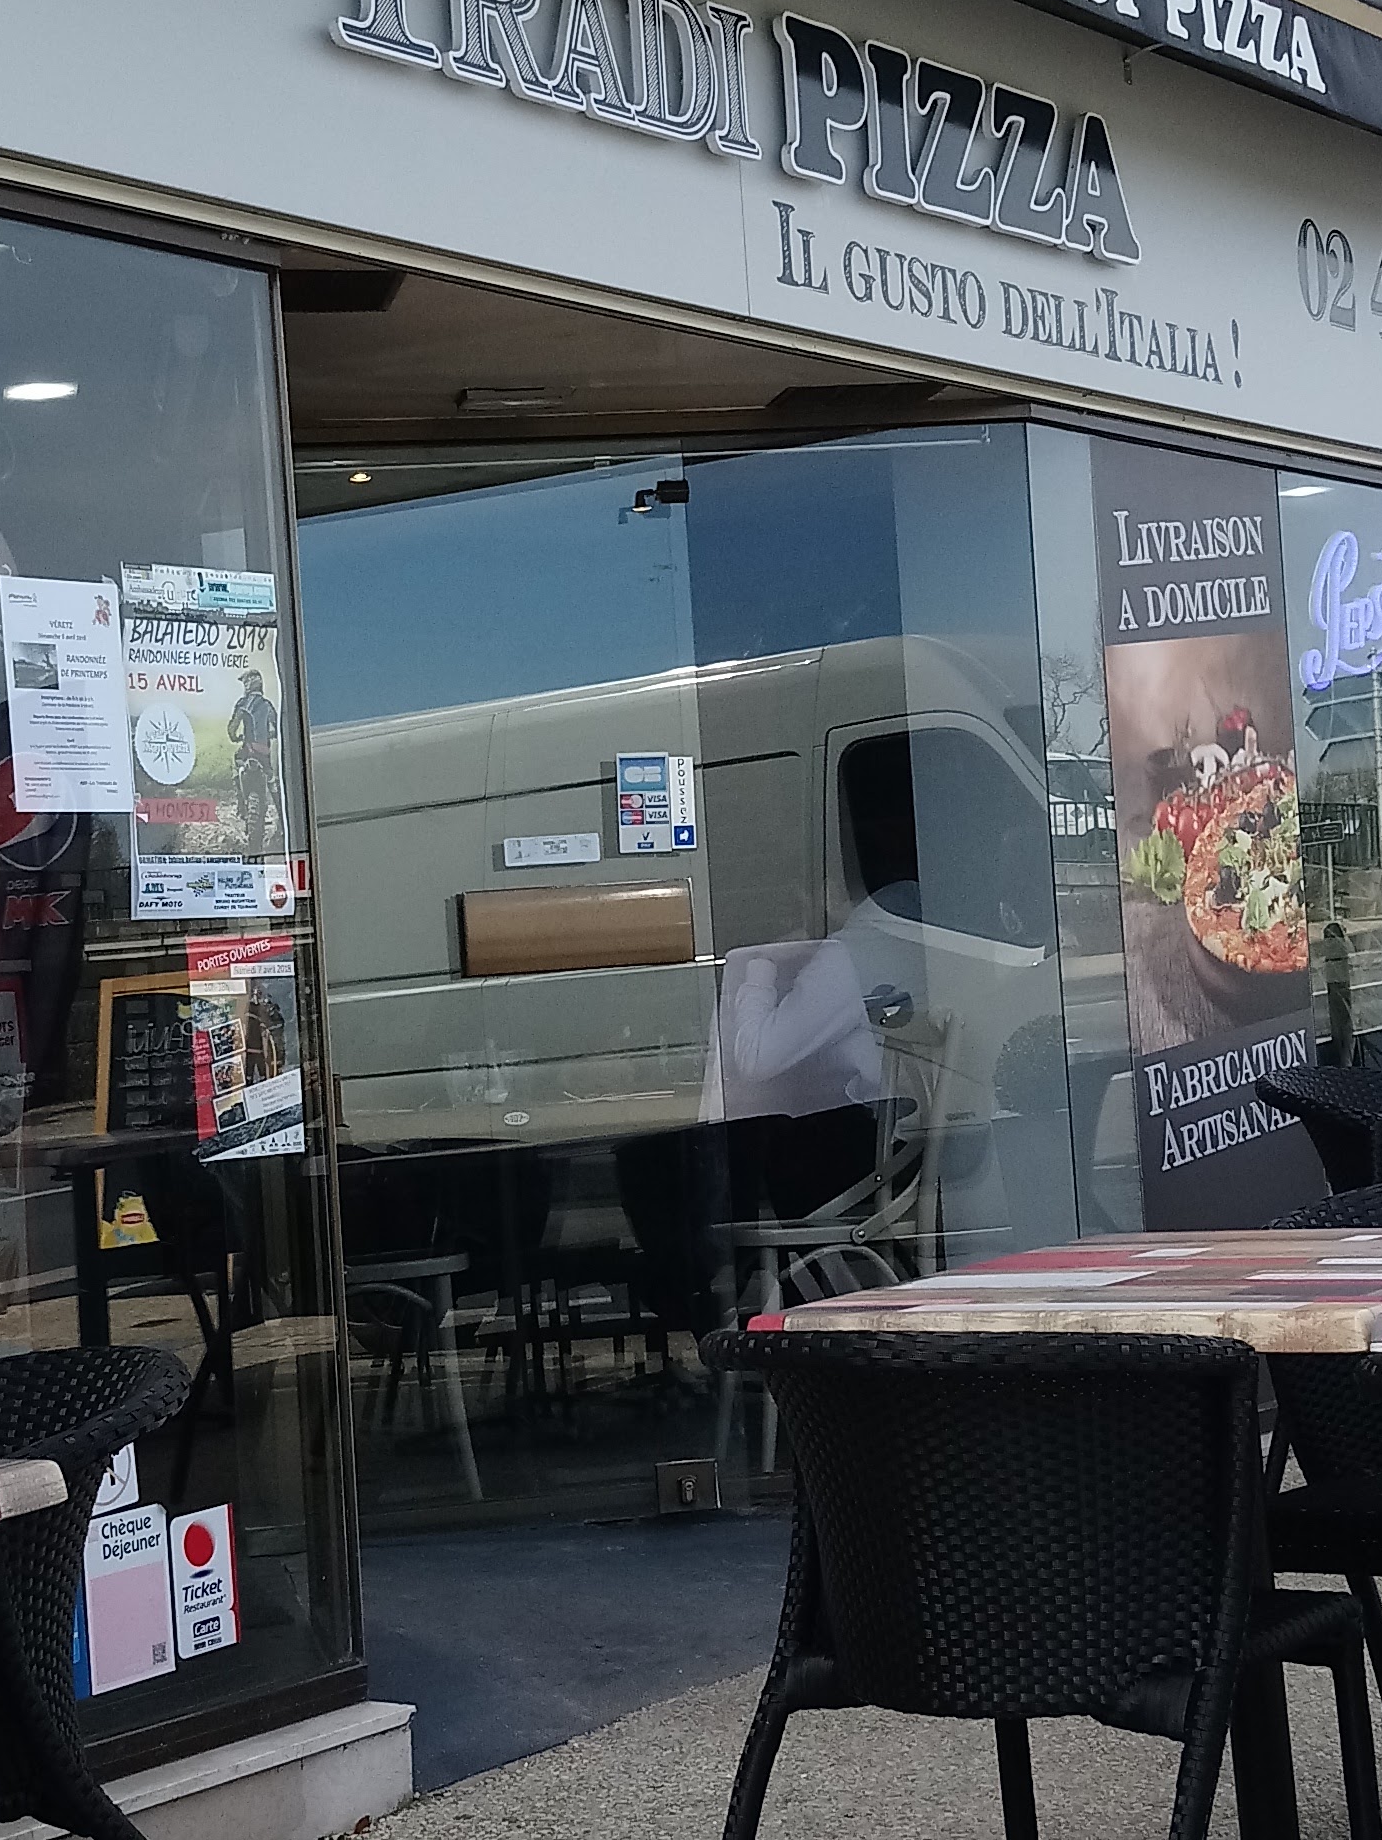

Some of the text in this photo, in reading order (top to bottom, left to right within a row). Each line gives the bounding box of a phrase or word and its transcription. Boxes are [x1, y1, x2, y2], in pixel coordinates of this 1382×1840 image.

[773, 9, 1141, 265] PIZZA
[843, 240, 986, 330] GUSTO
[1297, 218, 1356, 332] 02
[1113, 511, 1264, 565] LIVRAISON
[1119, 576, 1270, 630] A DOMICILE
[226, 625, 268, 652] 2018
[129, 648, 249, 668] RANDONNEE MOTO VERTE
[61, 669, 108, 679] DE PRINTEMPS
[128, 673, 204, 693] 15 AVRIL
[647, 794, 667, 803] VISA
[677, 758, 687, 824] poussez
[648, 811, 668, 819] VISA
[197, 938, 271, 972] PORTES OUVERTES
[233, 966, 256, 974] Samedi
[262, 964, 276, 974] avril
[277, 964, 292, 974] 2018
[1144, 1029, 1308, 1116] FABRICATION
[1161, 1101, 1300, 1172] ARTISANA
[101, 1515, 152, 1541] Chèque
[102, 1531, 161, 1560] Déjeuner
[182, 1578, 223, 1604] Ticket
[194, 1619, 219, 1636] Carte
